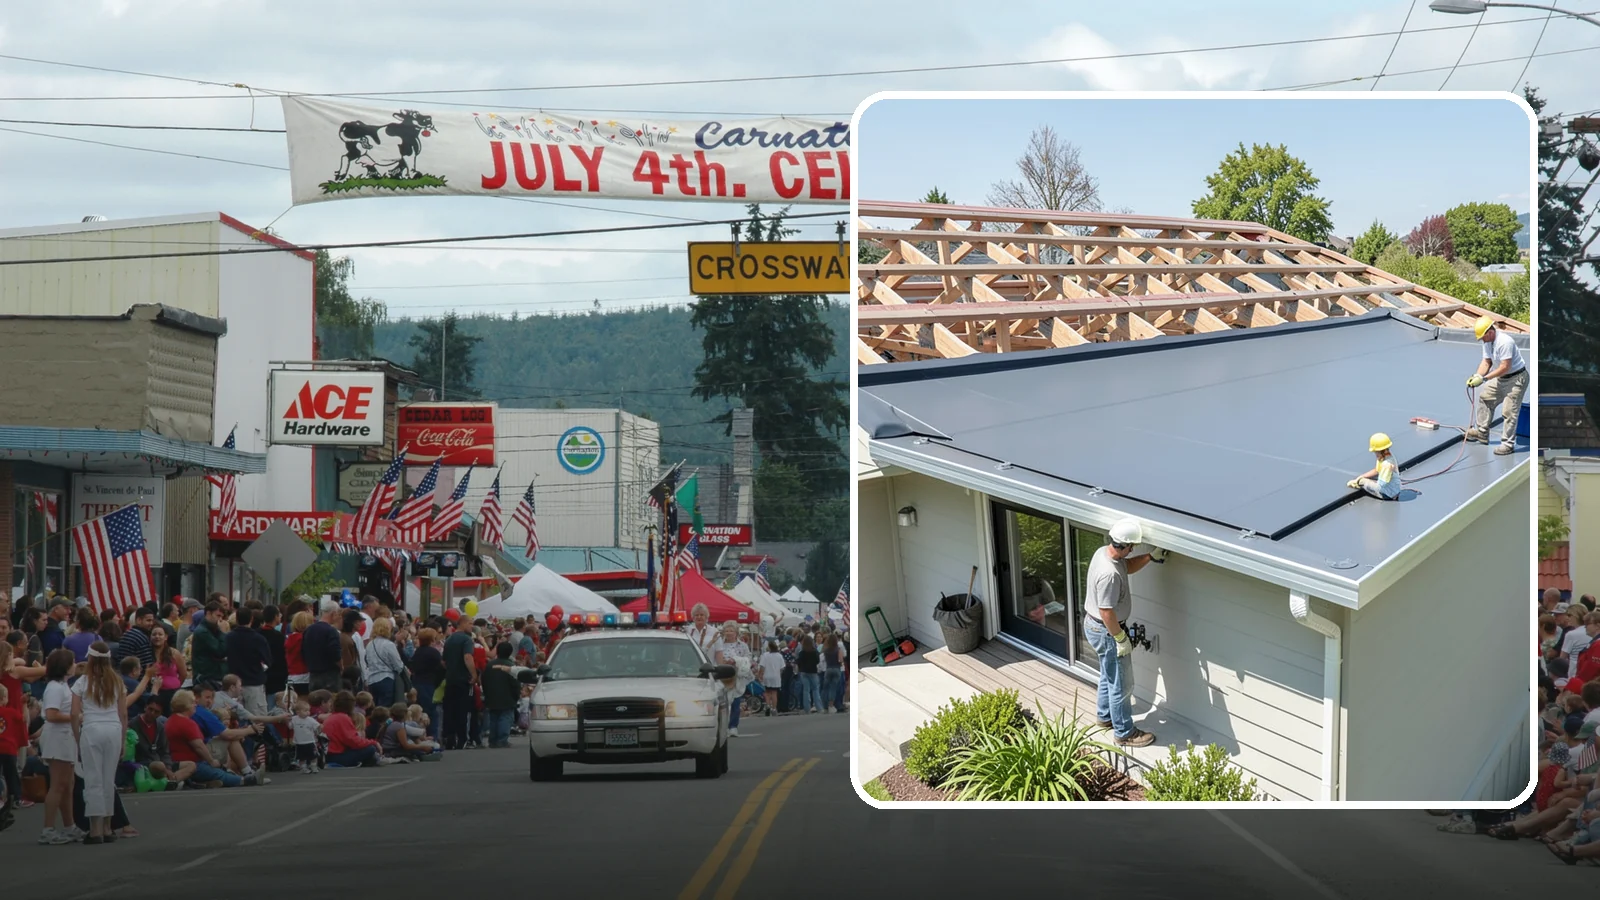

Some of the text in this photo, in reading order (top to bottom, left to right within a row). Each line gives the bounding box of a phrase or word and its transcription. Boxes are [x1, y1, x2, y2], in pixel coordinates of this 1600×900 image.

[481, 141, 605, 193] JULY
[632, 149, 746, 197] 4th.
[697, 254, 850, 281] CROSSWA
[283, 380, 373, 420] ACE
[405, 409, 485, 422] CEDAR LOG
[283, 421, 371, 437] Hardware
[416, 428, 477, 447] Coca-Cola
[353, 467, 385, 480] Simpl
[83, 485, 155, 495] St. Vincent de Paul
[688, 526, 741, 535] CRNATION
